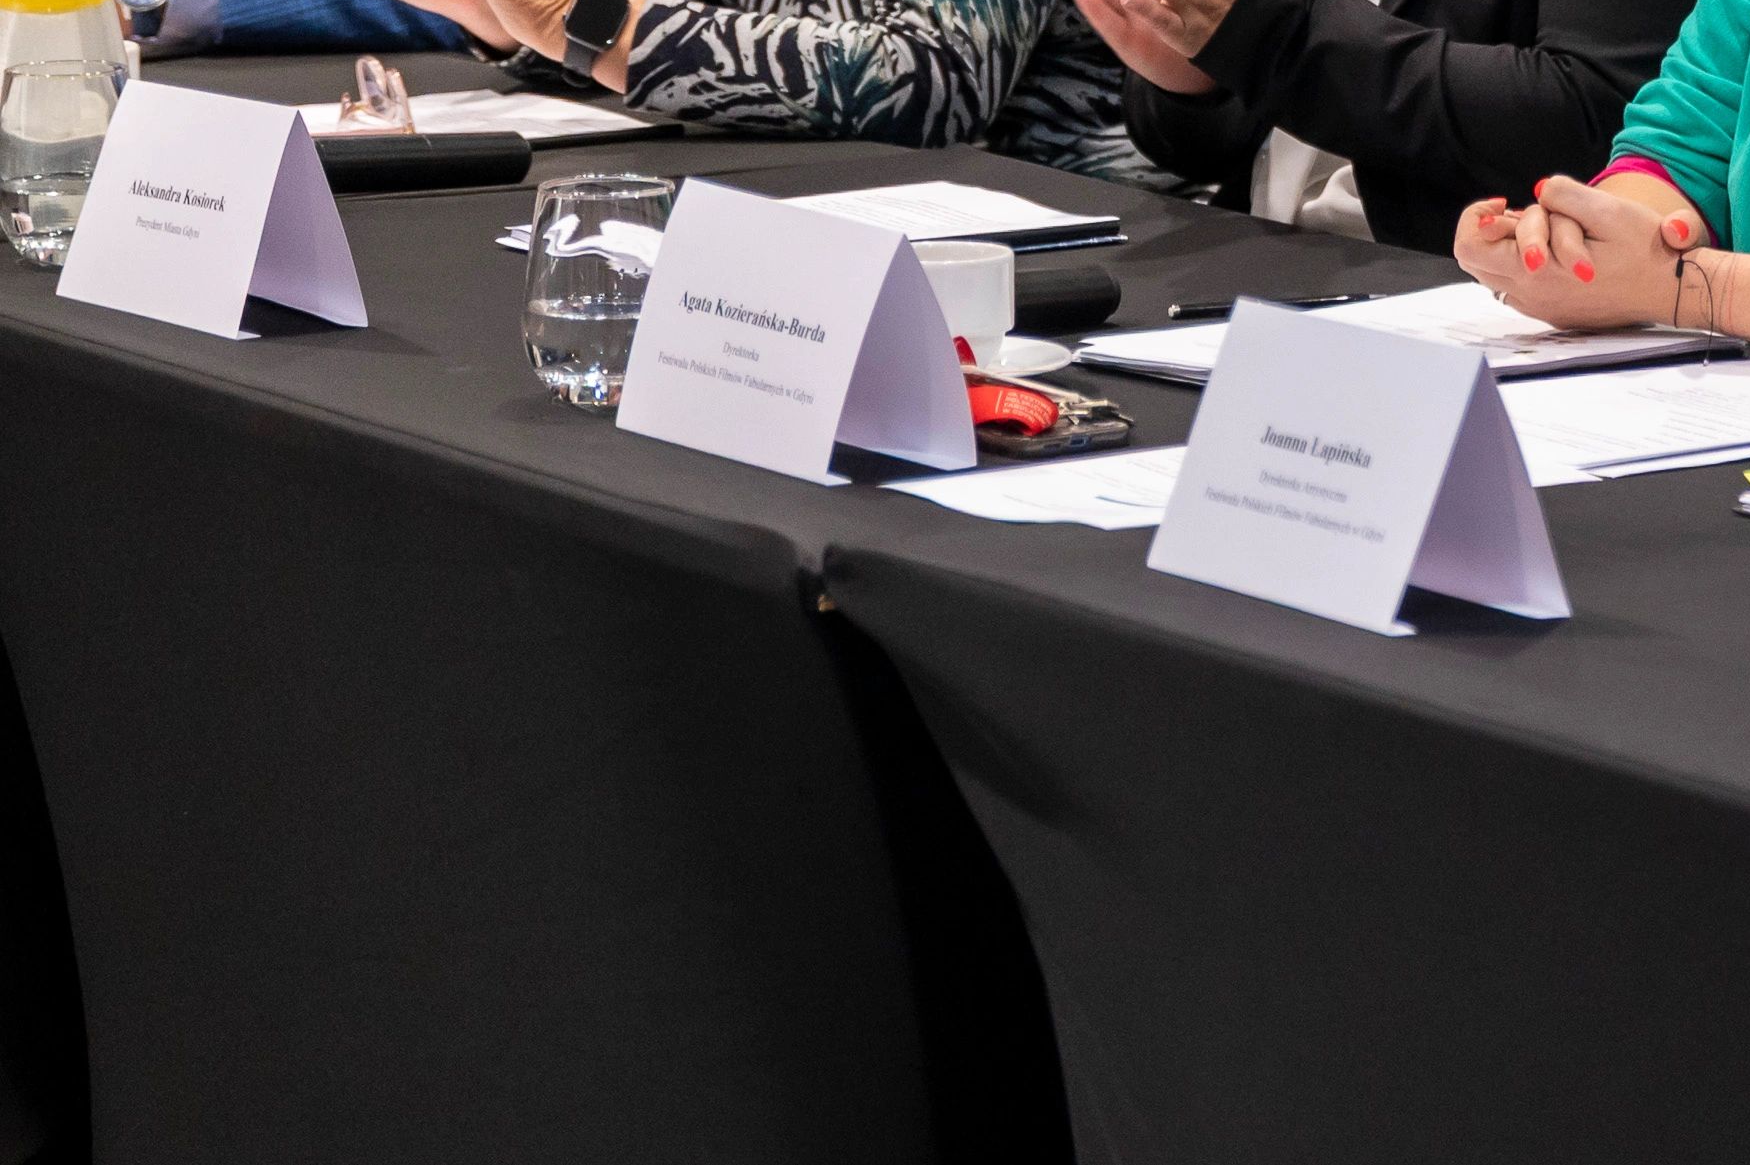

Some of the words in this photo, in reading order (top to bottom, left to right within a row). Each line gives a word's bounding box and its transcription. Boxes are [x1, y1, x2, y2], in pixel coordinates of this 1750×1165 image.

[128, 179, 182, 204] Aleksandra
[183, 188, 227, 213] Kosiorek
[679, 290, 713, 314] Agata
[714, 298, 826, 344] Kozierańska-Burda
[722, 341, 760, 362] Dyrektorka
[792, 387, 814, 405] Gdyni
[1260, 425, 1307, 454] Joanna
